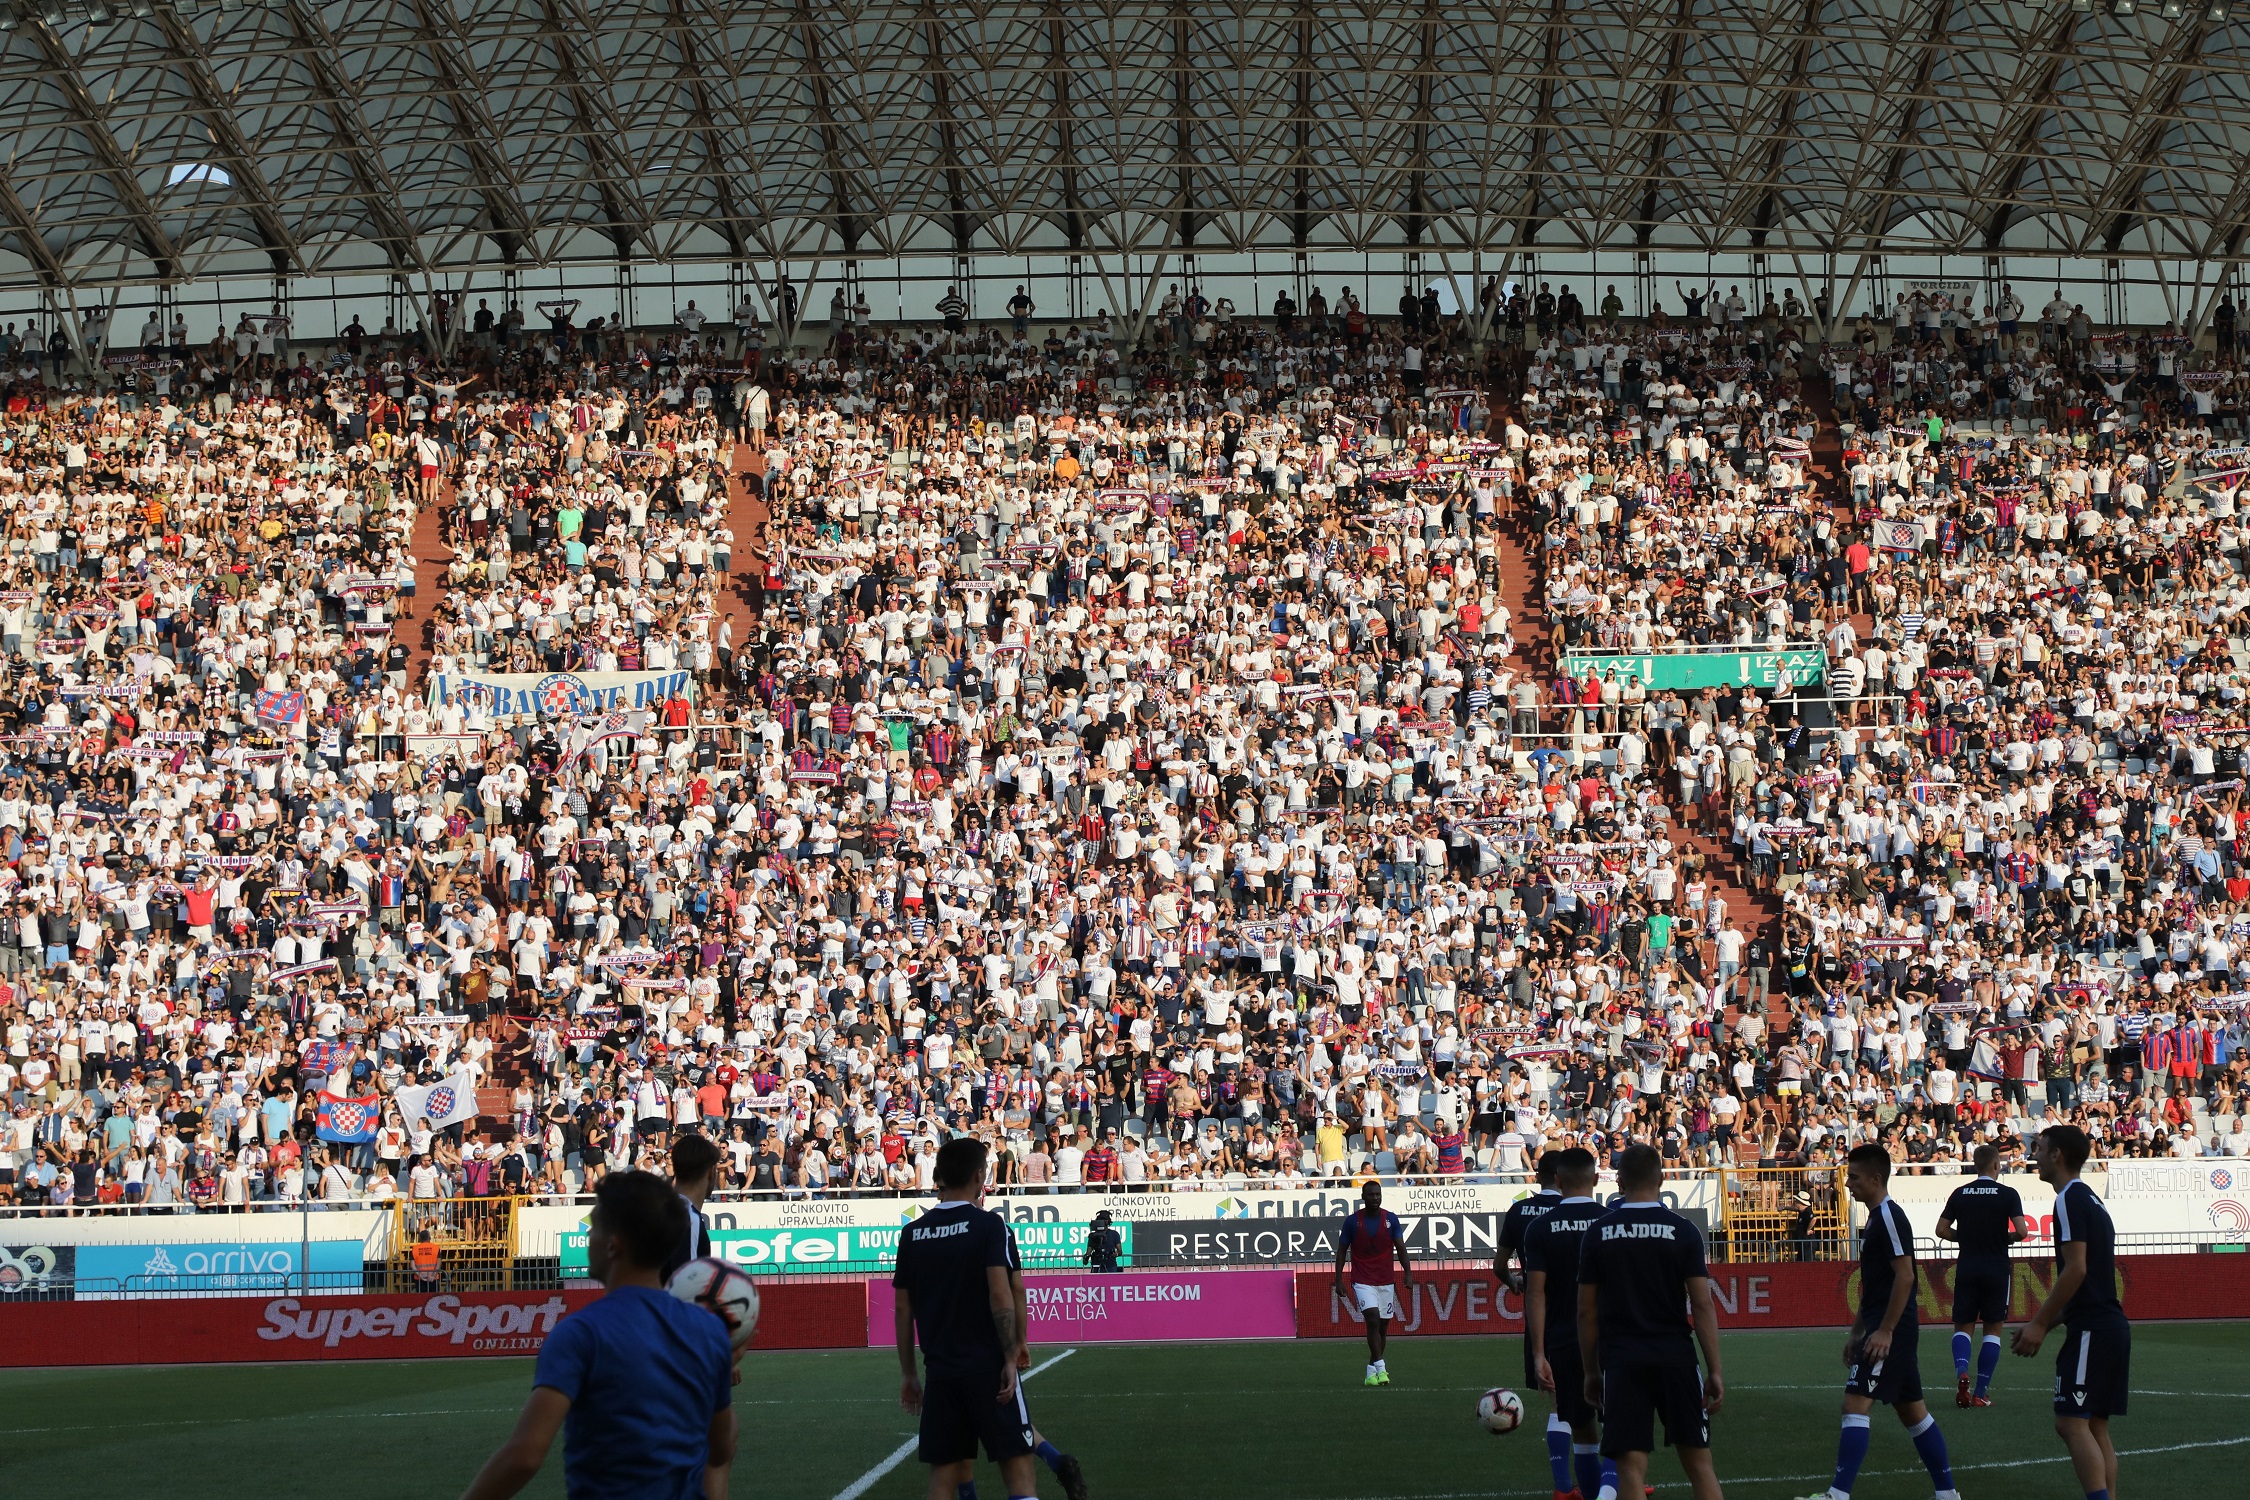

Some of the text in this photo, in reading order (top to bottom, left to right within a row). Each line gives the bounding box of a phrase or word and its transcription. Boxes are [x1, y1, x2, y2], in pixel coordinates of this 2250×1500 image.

[1910, 281, 1971, 291] TORCIDA
[1574, 659, 1636, 673] IZLAZ
[539, 674, 584, 690] HAJDUK
[1763, 669, 1812, 683] EIT
[259, 704, 283, 717] VJEČNO
[146, 730, 199, 741] HAJDUK
[119, 748, 166, 757] HAJDUK
[1812, 773, 1836, 783] AJDUK
[202, 855, 255, 865] HAJDUK
[1552, 855, 1581, 863] HAJDUK
[607, 954, 653, 963] HAJDUK
[1520, 1045, 1543, 1053] HAJDUK
[1381, 1065, 1420, 1075] HAJDUK
[427, 1087, 453, 1105] HAJDUK
[745, 1096, 788, 1106] Hajduk Split
[331, 1101, 365, 1115] HAJDUK
[432, 1105, 453, 1119] SPLIT
[337, 1127, 357, 1136] SPLIT
[2108, 1167, 2206, 1192] TORCIDA
[1409, 1188, 1476, 1200] UČINKOVITO
[1962, 1187, 1999, 1196] HAJDUK
[1103, 1196, 1171, 1207] UČINKOVITO
[1405, 1199, 1482, 1212] UPRAVLJANJE
[782, 1203, 850, 1215] UČINKOVITO
[991, 1200, 1060, 1224] dan
[1107, 1207, 1177, 1218] PRAVLJANJE
[1520, 1205, 1556, 1217] HAJD
[778, 1214, 855, 1226] UPRAVLJANJE
[1550, 1218, 1600, 1234] HAJD
[911, 1220, 970, 1242] HAJDUK
[1014, 1227, 1047, 1246] LON
[1052, 1226, 1065, 1245] U
[1393, 1214, 1499, 1254] ZRN
[1601, 1223, 1676, 1242] HAJDUK
[568, 1235, 591, 1249] UG
[710, 1231, 849, 1264] pfel
[1169, 1230, 1342, 1260] RESTORA
[184, 1245, 292, 1275] arriva
[221, 1276, 236, 1286] DB
[238, 1275, 292, 1286] company
[1026, 1284, 1200, 1304] RVATSKI TELEKOM
[1027, 1303, 1108, 1321] RVA LIGA
[256, 1294, 568, 1348] SuperSport
[472, 1336, 545, 1350] ONLINE
